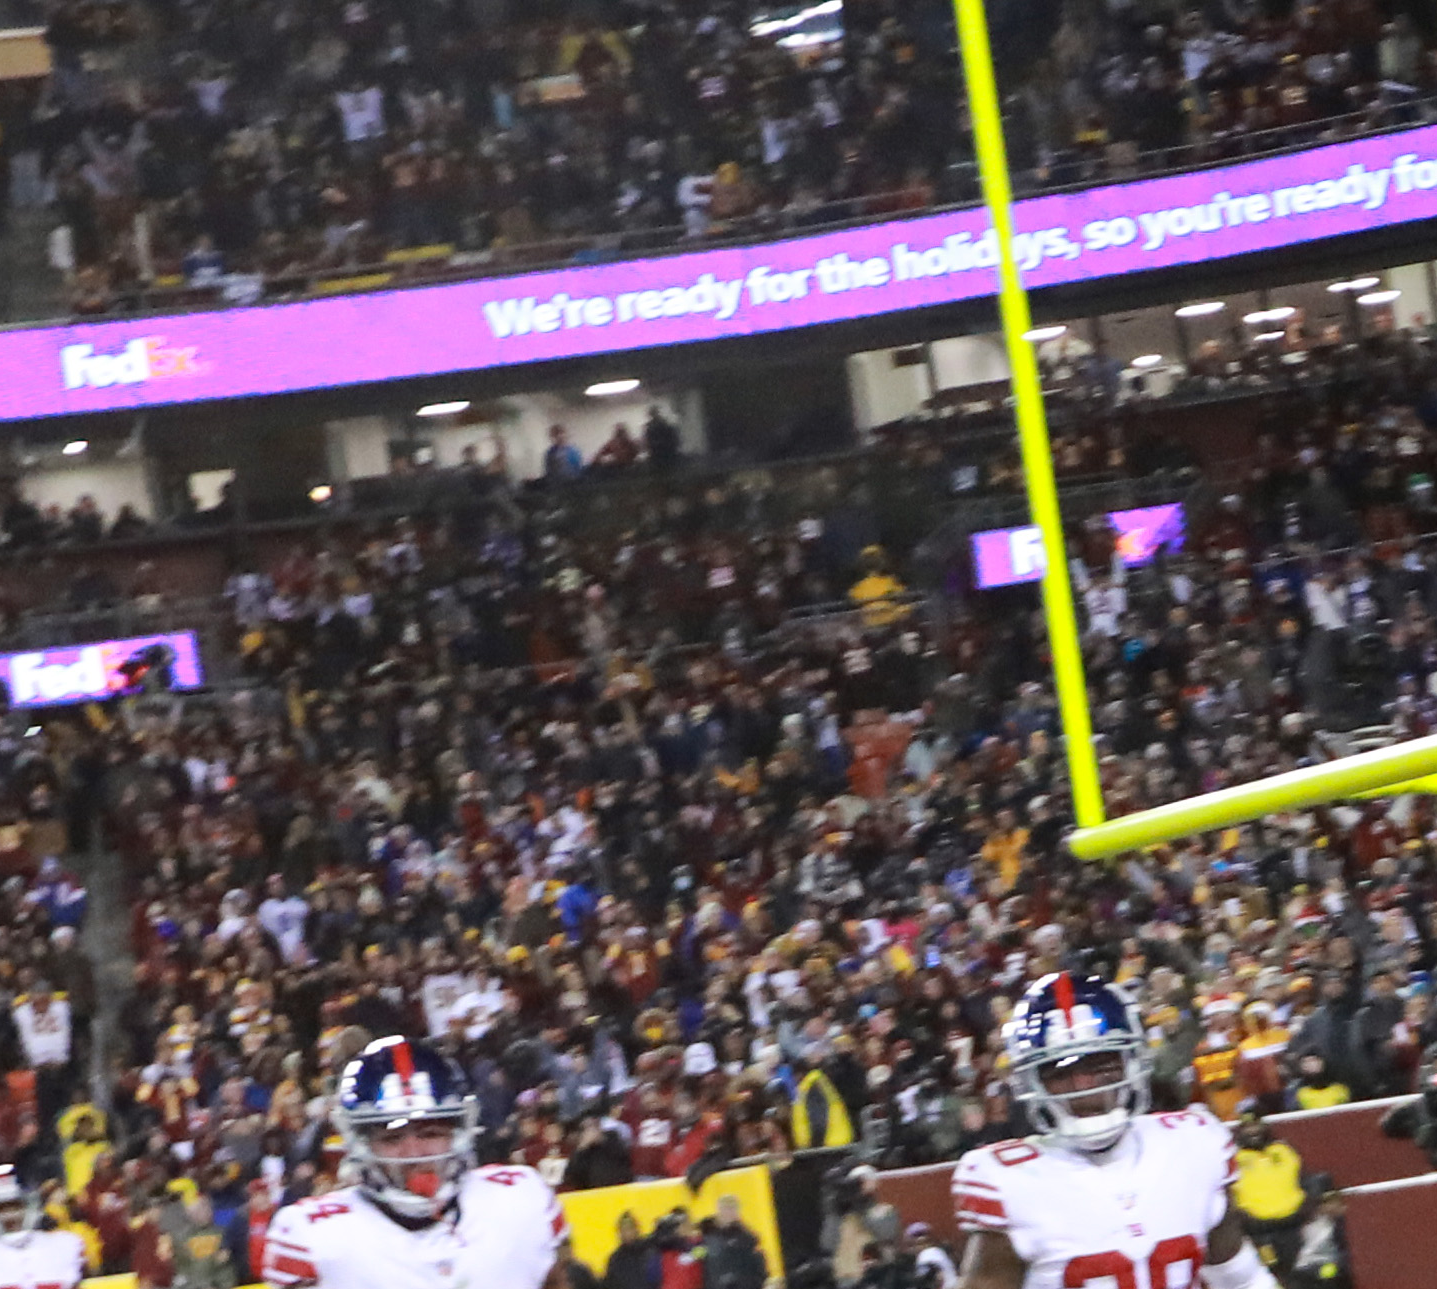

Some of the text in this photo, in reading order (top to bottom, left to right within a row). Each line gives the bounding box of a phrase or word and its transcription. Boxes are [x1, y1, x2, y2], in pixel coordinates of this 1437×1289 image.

[483, 293, 612, 338] We're
[616, 273, 744, 320] ready
[745, 266, 814, 306] for
[815, 253, 890, 295] the
[891, 226, 1080, 282] holidys,
[1084, 213, 1136, 250] so
[1139, 191, 1270, 250] you're
[1272, 163, 1390, 211] ready
[59, 335, 201, 390] FedEx
